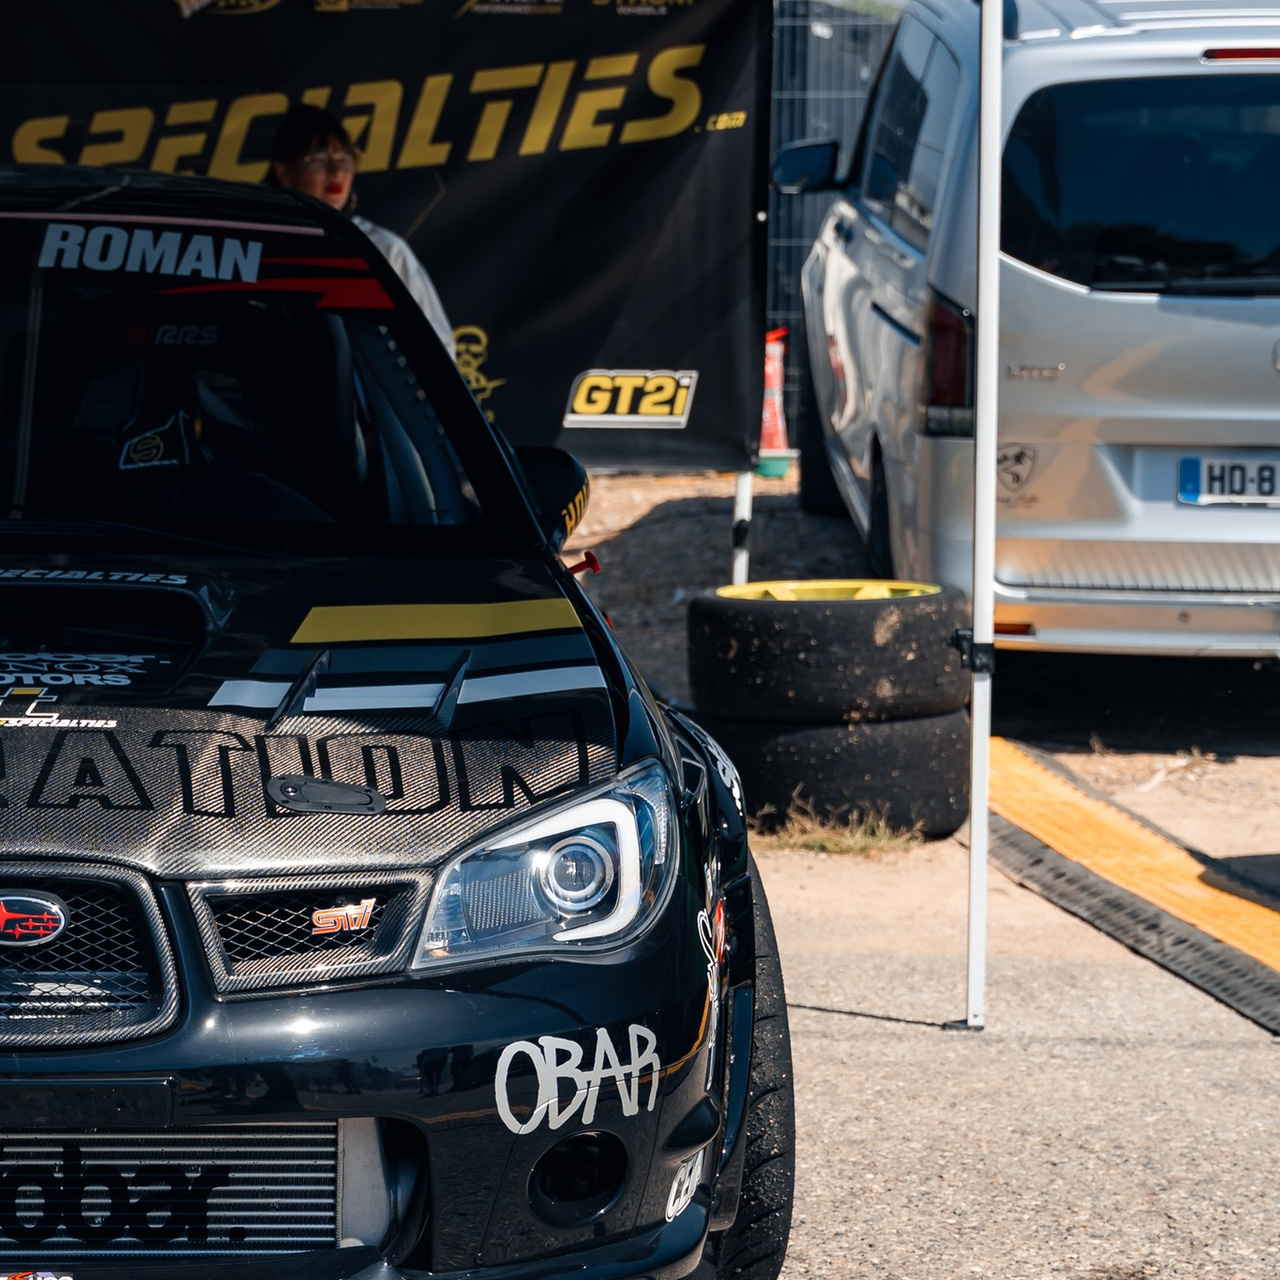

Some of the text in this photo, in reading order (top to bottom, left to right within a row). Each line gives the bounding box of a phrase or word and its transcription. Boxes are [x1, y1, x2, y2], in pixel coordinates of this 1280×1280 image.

[37, 222, 264, 284] ROMAN
[571, 373, 694, 417] GT2i
[494, 1024, 662, 1135] OBAR
